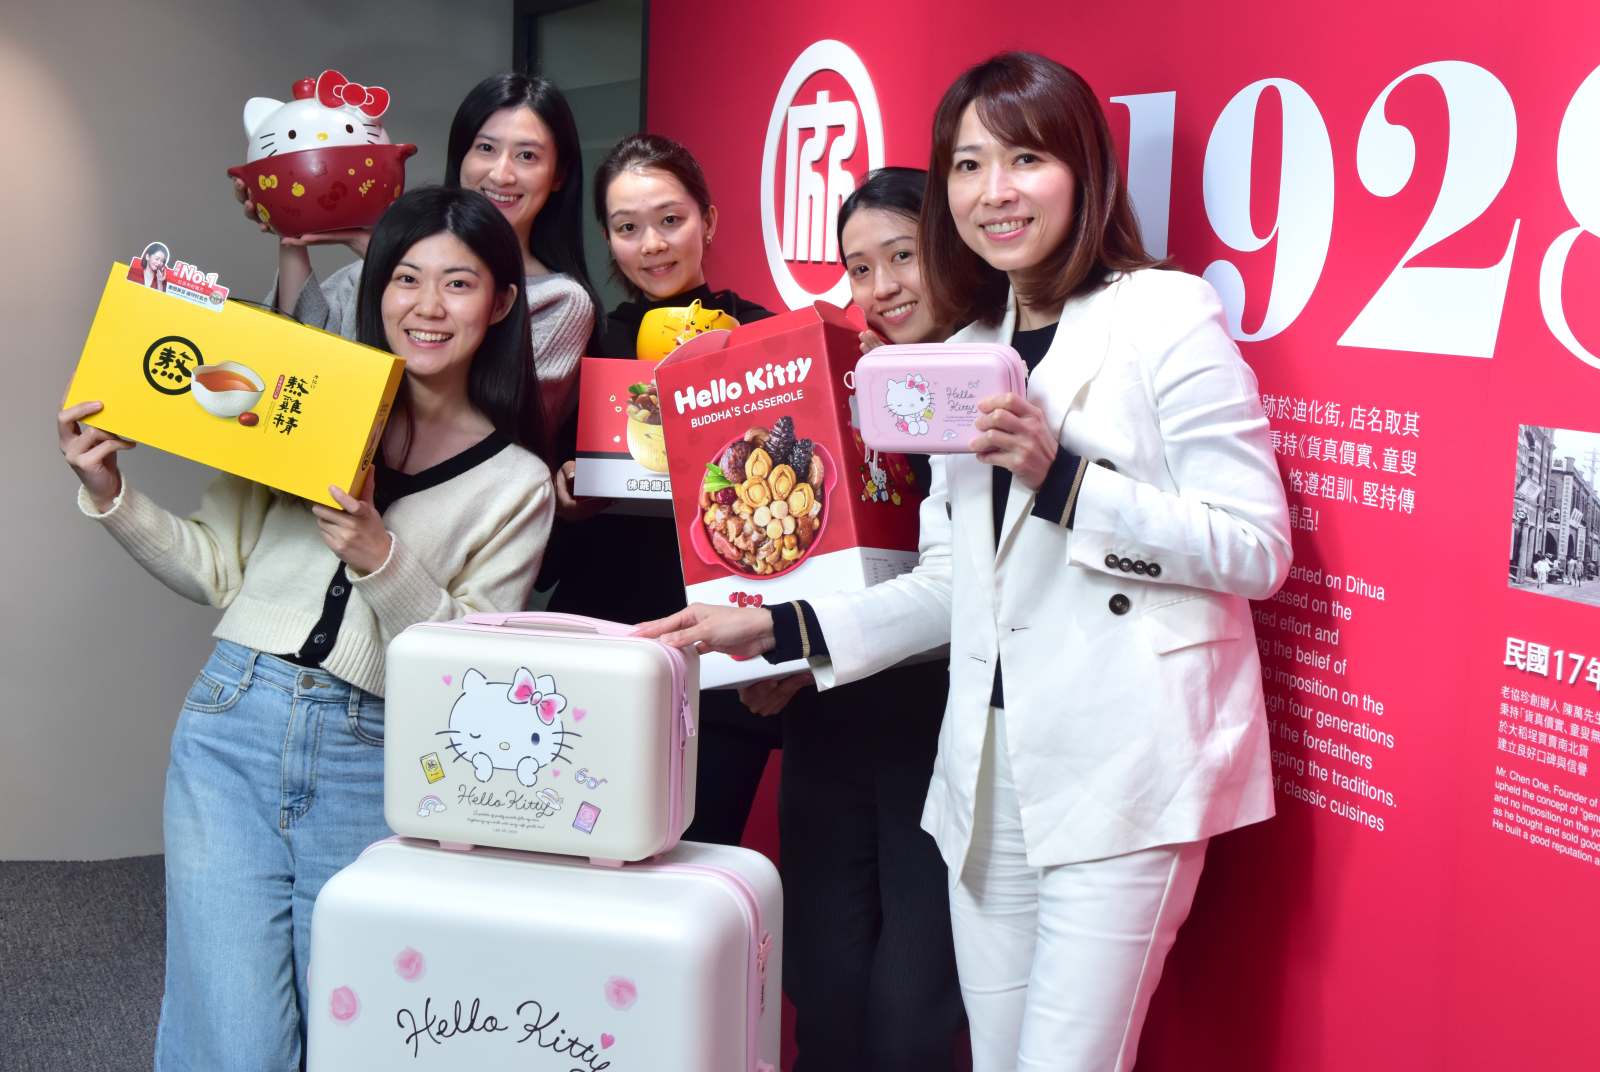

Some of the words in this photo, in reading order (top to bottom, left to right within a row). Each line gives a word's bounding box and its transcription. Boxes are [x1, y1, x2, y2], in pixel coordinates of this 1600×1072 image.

[674, 378, 743, 415] Hello
[745, 357, 813, 395] Kitty
[945, 386, 975, 400] Hello
[691, 404, 741, 429] BUDDHA'S
[743, 389, 805, 414] CASSEROLE
[1288, 565, 1322, 585] arted
[1325, 574, 1342, 590] on
[1346, 575, 1385, 601] Dihua
[1312, 598, 1328, 614] on
[1332, 601, 1352, 621] the
[1280, 616, 1311, 638] effort
[1315, 627, 1339, 646] and
[1274, 640, 1292, 660] the
[1296, 645, 1331, 670] belief
[1334, 659, 1348, 676] of
[1503, 636, 1600, 693] 民國17年
[1275, 666, 1338, 702] imposition
[1342, 691, 1359, 708] on
[1363, 695, 1384, 716] the
[1288, 697, 1314, 720] four
[1316, 710, 1395, 749] generations
[1280, 722, 1300, 743] the
[1302, 729, 1373, 770] forefathers
[457, 783, 505, 807] Hello
[505, 789, 555, 818] Kitty
[1308, 761, 1329, 782] the
[1331, 769, 1398, 809] traditions.
[1495, 780, 1521, 796] upheld
[1522, 789, 1535, 800] the
[1536, 794, 1568, 812] concept
[1569, 805, 1578, 815] of
[1509, 770, 1531, 785] Chen
[1553, 785, 1588, 804] Founder
[1589, 798, 1599, 807] of
[1284, 780, 1327, 809] classic
[1330, 798, 1385, 832] cuisines
[1493, 807, 1503, 816] as
[1504, 810, 1514, 820] he
[1516, 814, 1543, 831] bought
[1544, 824, 1560, 837] and
[1561, 830, 1579, 844] sold
[1494, 794, 1509, 805] and
[1510, 800, 1521, 809] no
[1522, 802, 1562, 822] imposition
[1563, 817, 1574, 828] on
[1576, 820, 1589, 833] the
[1492, 818, 1504, 831] He
[1505, 823, 1521, 838] built
[1530, 833, 1550, 848] good
[1552, 841, 1592, 863] reputation
[396, 997, 508, 1059] Hello
[516, 1000, 611, 1072] Kitty
